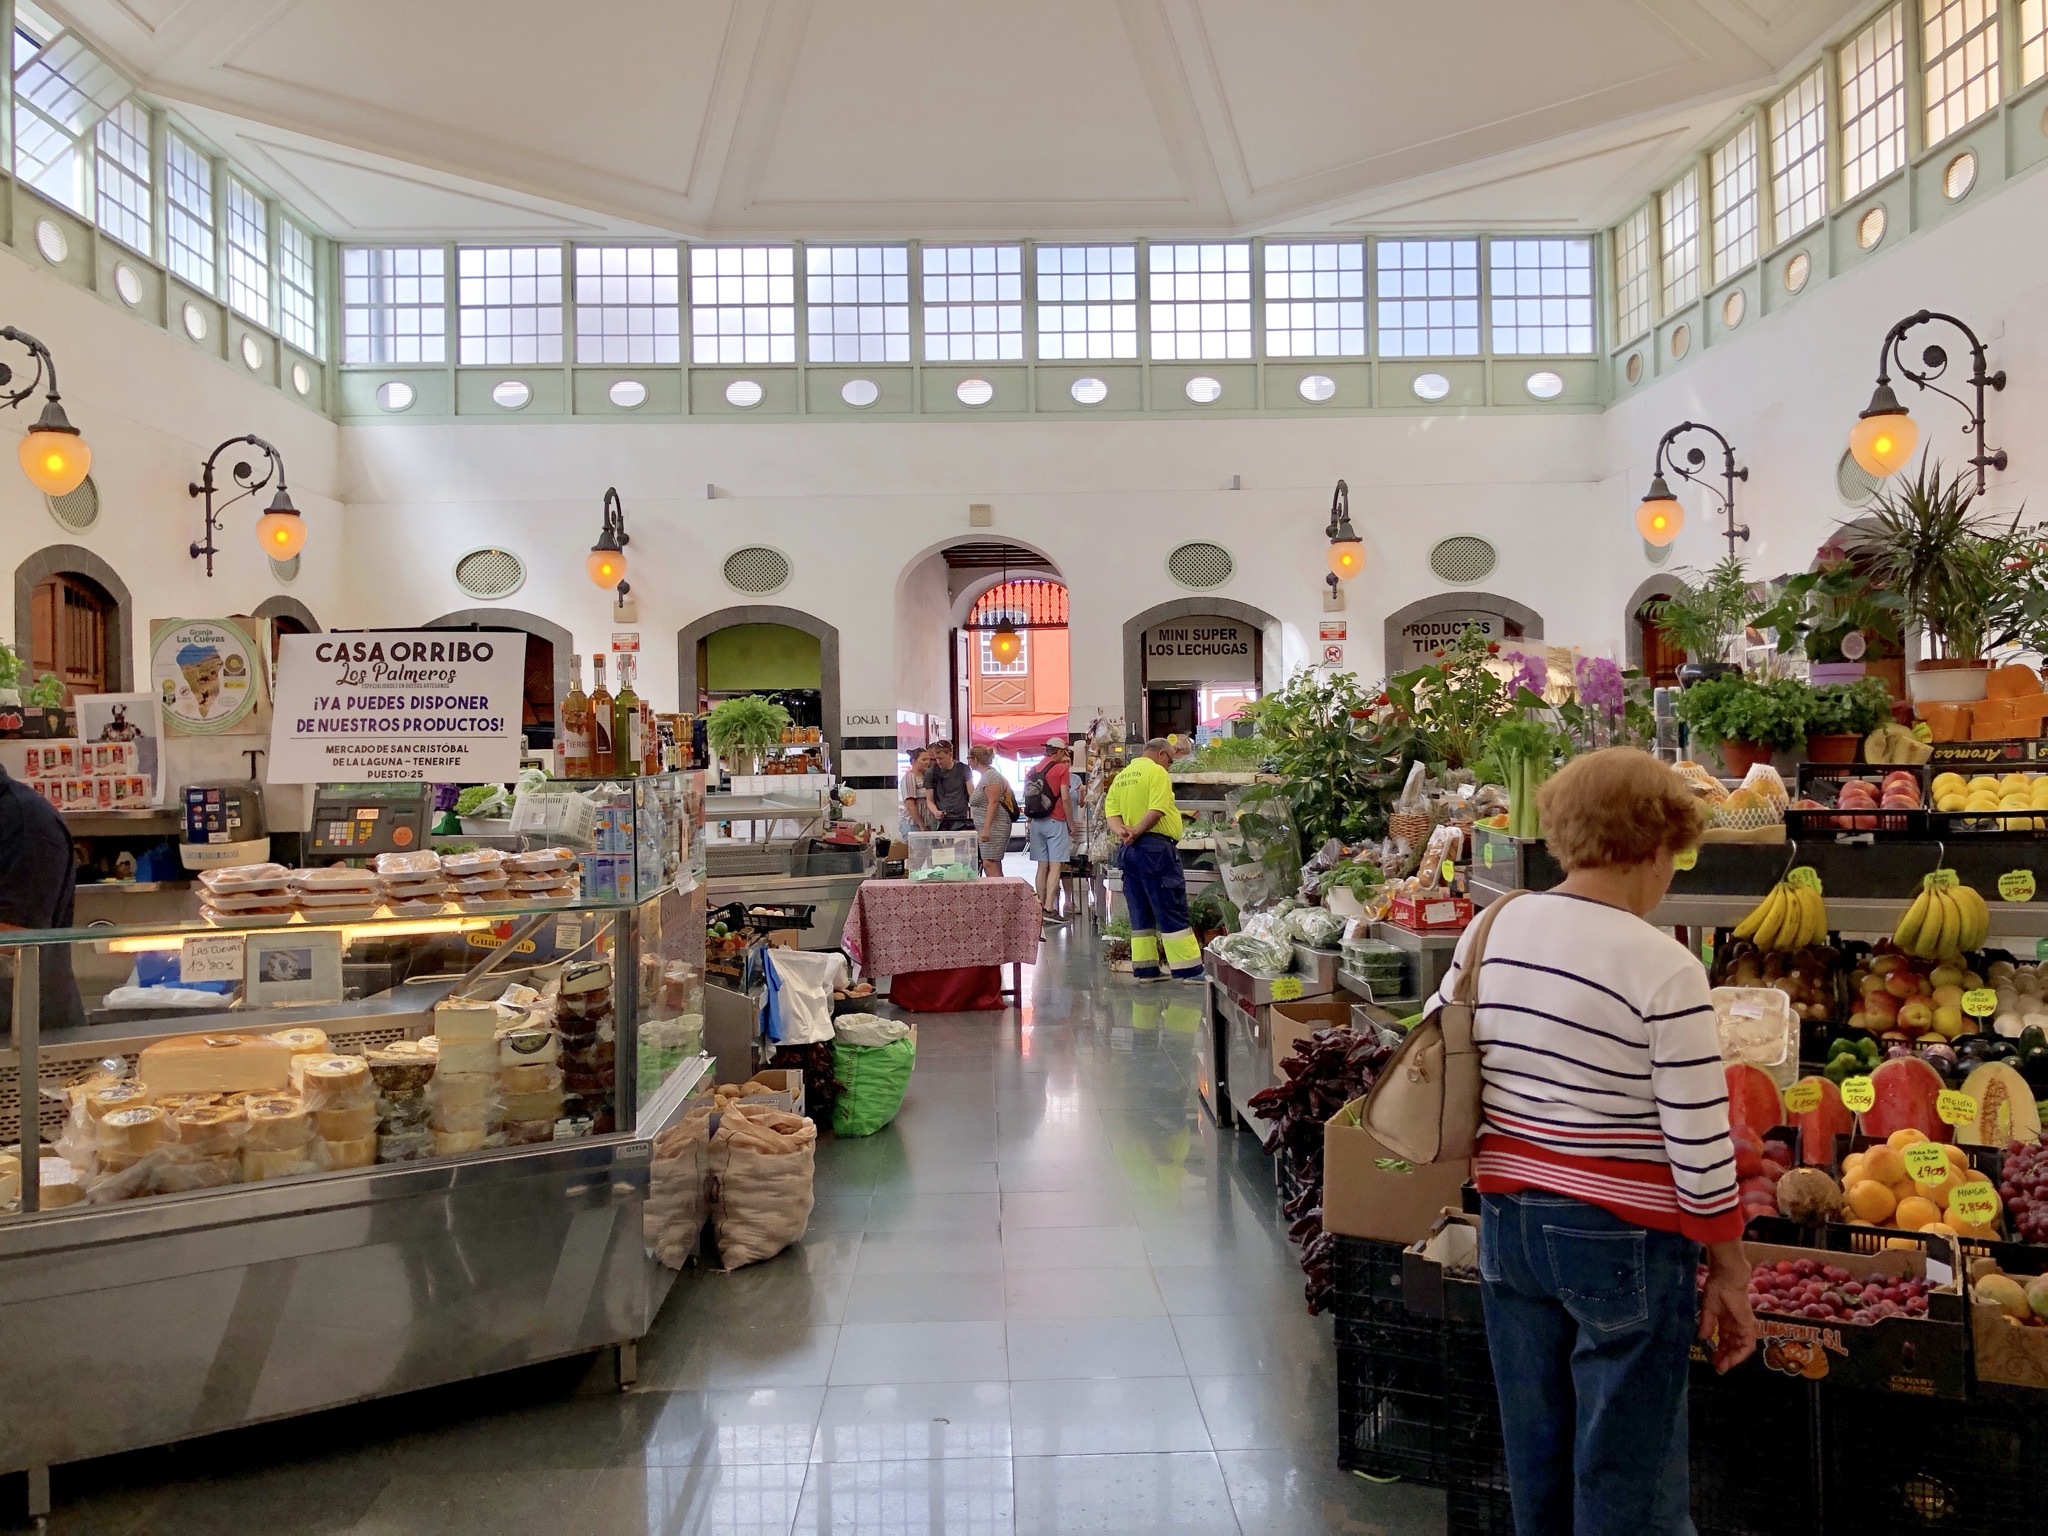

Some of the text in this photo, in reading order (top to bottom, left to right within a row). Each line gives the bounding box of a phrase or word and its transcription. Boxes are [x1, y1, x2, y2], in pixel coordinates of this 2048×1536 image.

[189, 629, 213, 637] Granja
[1159, 628, 1237, 640] MINI SUPER
[1402, 622, 1491, 636] PRODUCTS
[194, 635, 225, 643] Cuevas
[315, 642, 494, 662] CASA ORRIBO
[1148, 643, 1248, 656] LOS LECHUGAS
[336, 662, 457, 686] Los Palmeros
[314, 696, 489, 711] ¡YA PUEDES DISPONER
[296, 717, 504, 732] DE NUESTROS PRODUCTOS!
[846, 715, 889, 725] LONJA 1
[325, 742, 469, 754] MERCADO DE SAN CRISTÓBAL
[1934, 748, 2002, 762] Aromas
[332, 757, 345, 766] DE
[346, 757, 359, 766] LA
[360, 757, 403, 766] LAGUNA
[413, 757, 461, 766] TENERIFE
[191, 946, 209, 957] LAS
[1957, 1186, 1988, 1198] MANGAS
